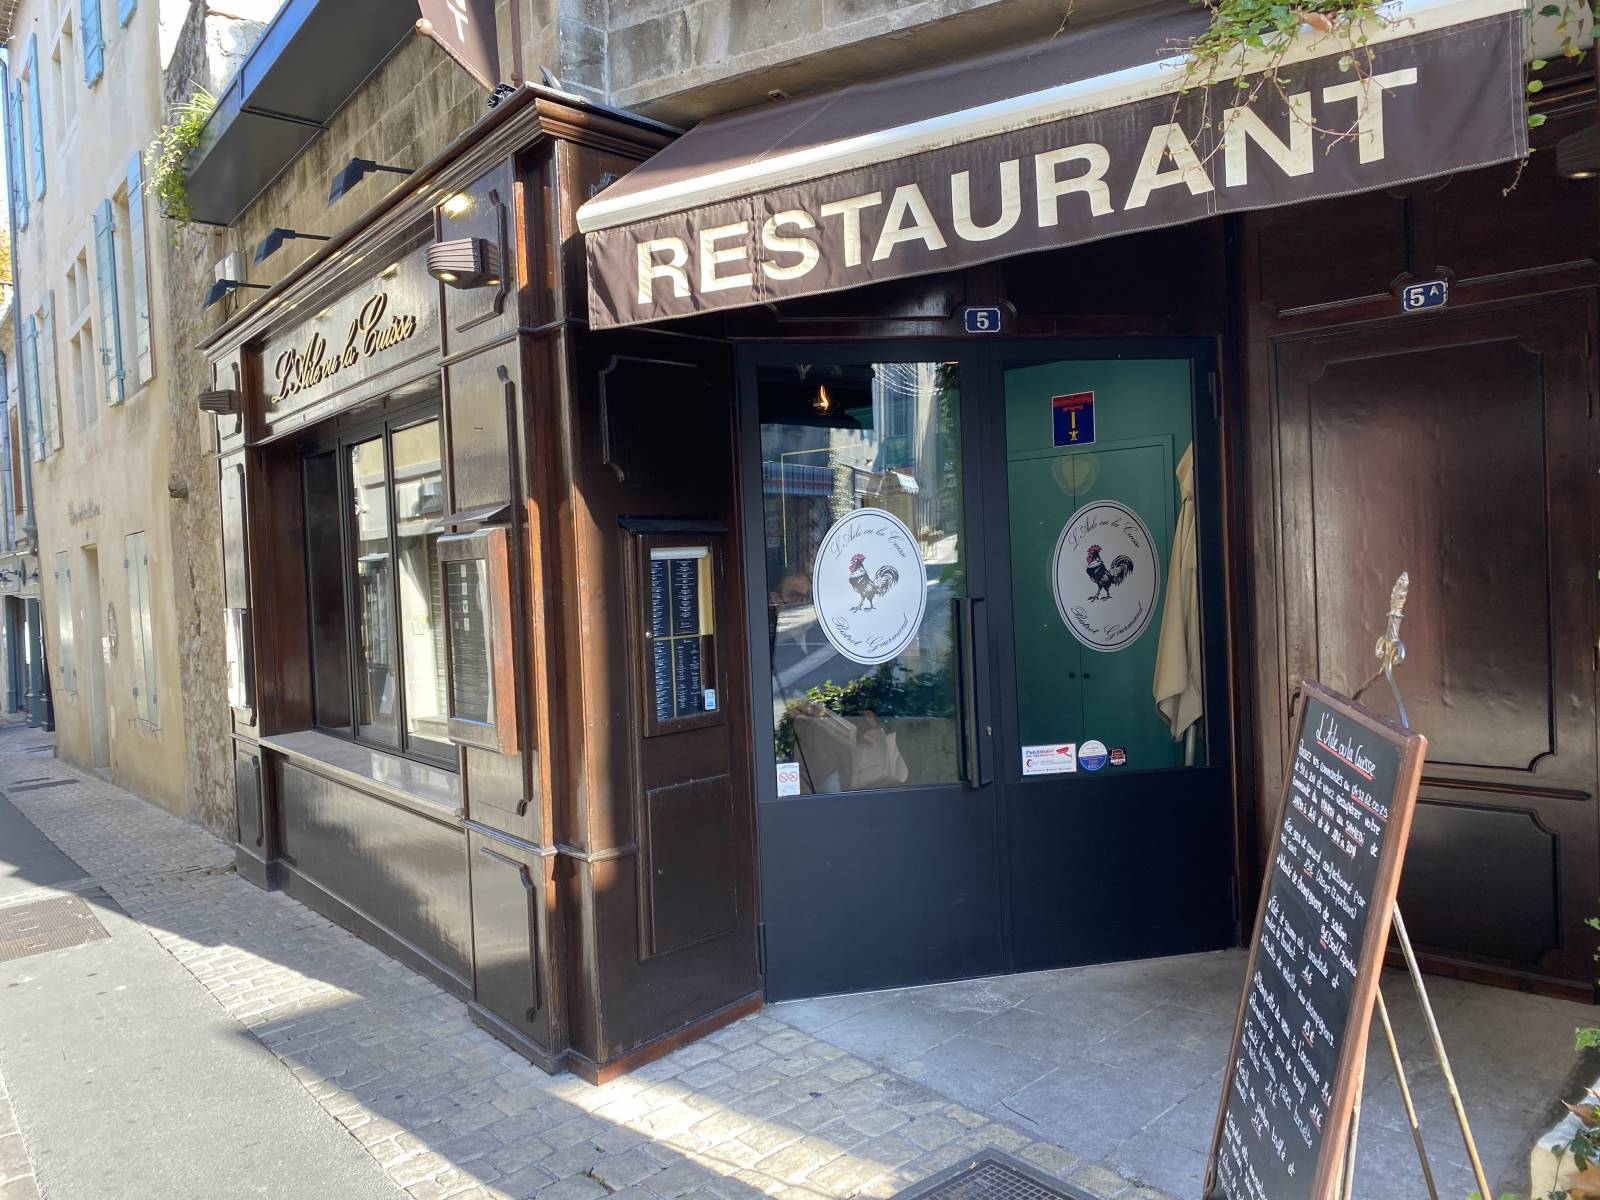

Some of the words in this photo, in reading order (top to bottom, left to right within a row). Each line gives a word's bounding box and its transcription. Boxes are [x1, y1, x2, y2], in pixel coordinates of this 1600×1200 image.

[636, 68, 1418, 305] RESTAURANT
[1410, 288, 1425, 307] 5
[1430, 285, 1440, 296] A
[976, 311, 990, 330] 5
[271, 332, 325, 404] L'Aile
[322, 355, 341, 379] ou
[342, 318, 359, 369] la
[358, 292, 416, 357] Cuisse
[1354, 745, 1375, 776] Cuisse
[1364, 818, 1380, 835] votre
[1370, 842, 1378, 857] de
[1291, 870, 1297, 884] de
[1322, 906, 1329, 922] de
[1353, 890, 1365, 907] par
[1331, 974, 1339, 988] et
[1274, 1005, 1280, 1023] de
[1267, 1025, 1274, 1043] de
[1285, 1057, 1291, 1074] de
[1287, 1162, 1295, 1176] et
